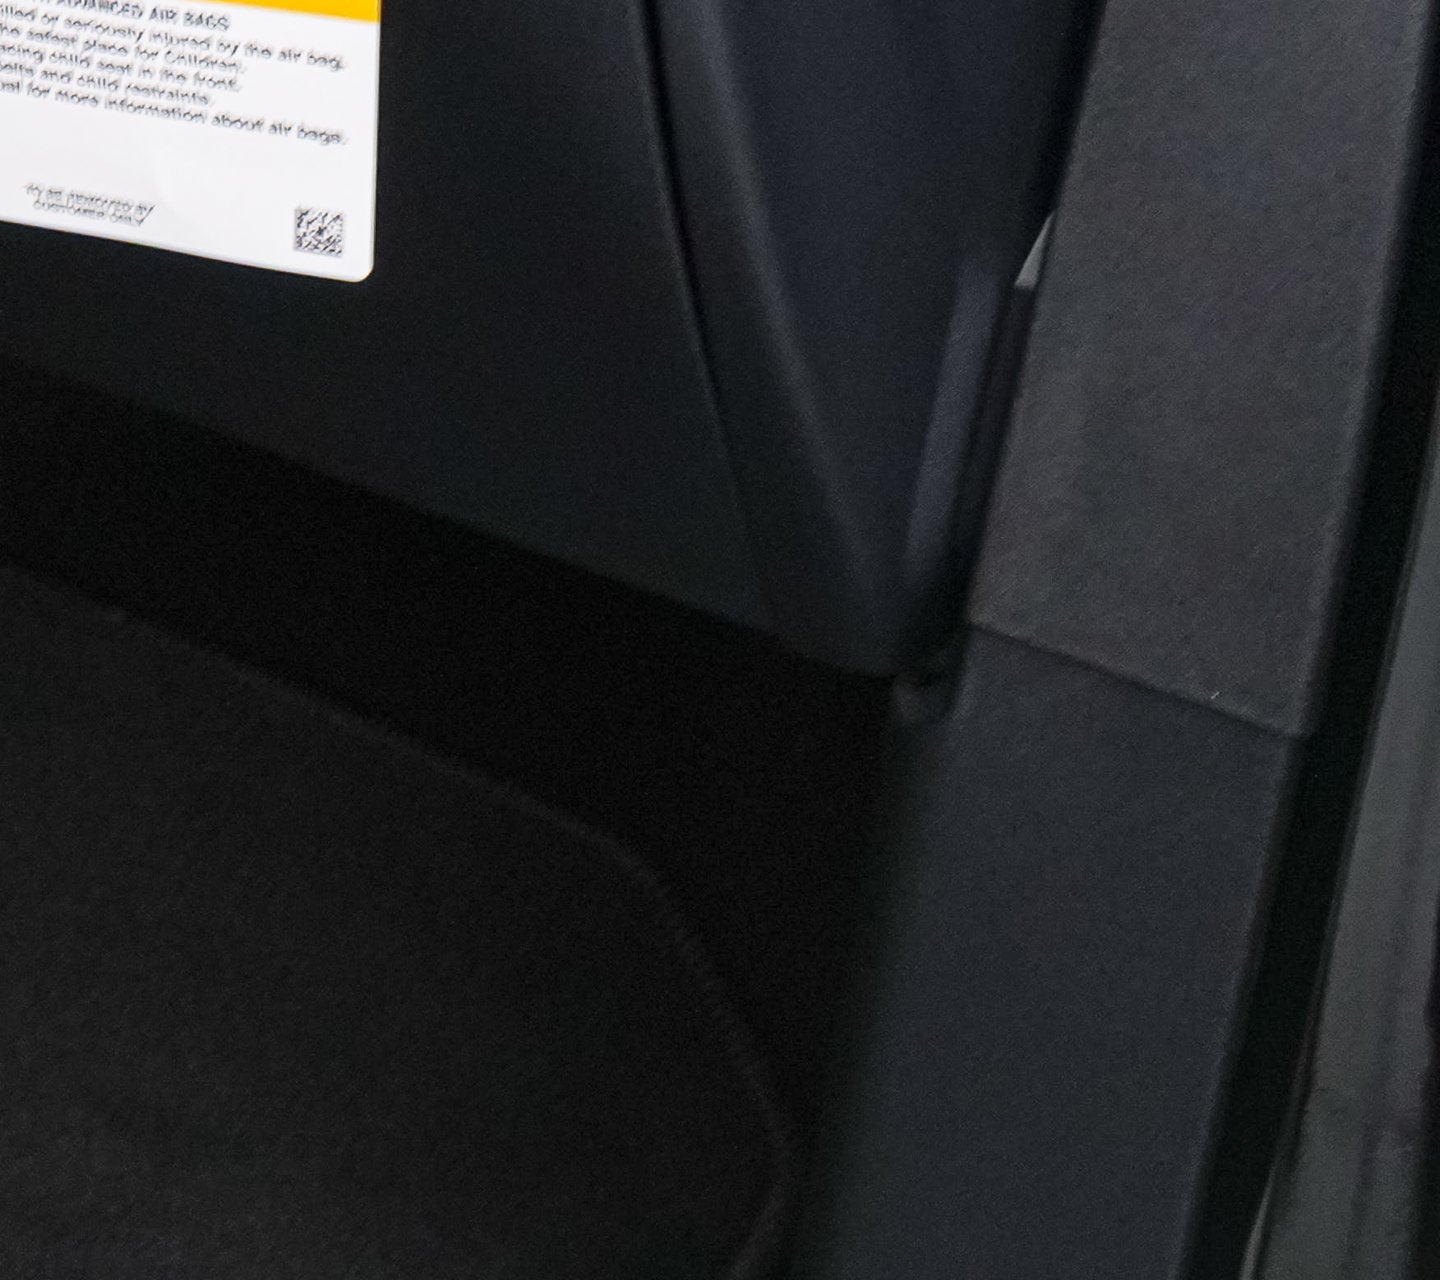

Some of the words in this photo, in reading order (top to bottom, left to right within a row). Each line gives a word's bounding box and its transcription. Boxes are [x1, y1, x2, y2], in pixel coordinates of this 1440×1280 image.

[148, 5, 176, 24] AIR
[184, 9, 229, 32] BAGS
[26, 28, 75, 47] safest
[82, 37, 127, 59] place
[134, 45, 159, 62] for
[42, 12, 58, 25] or
[64, 15, 145, 45] seriously
[148, 27, 209, 54] injured
[218, 39, 239, 58] by
[244, 40, 271, 59] the
[277, 46, 300, 64] air
[40, 67, 70, 84] and
[78, 72, 118, 93] child
[49, 48, 89, 69] child
[96, 58, 130, 76] seat
[138, 65, 152, 80] in
[159, 67, 185, 85] the
[26, 81, 48, 99] for
[54, 87, 97, 107] more
[104, 95, 204, 122] information
[211, 112, 263, 131] about
[269, 122, 291, 138] air
